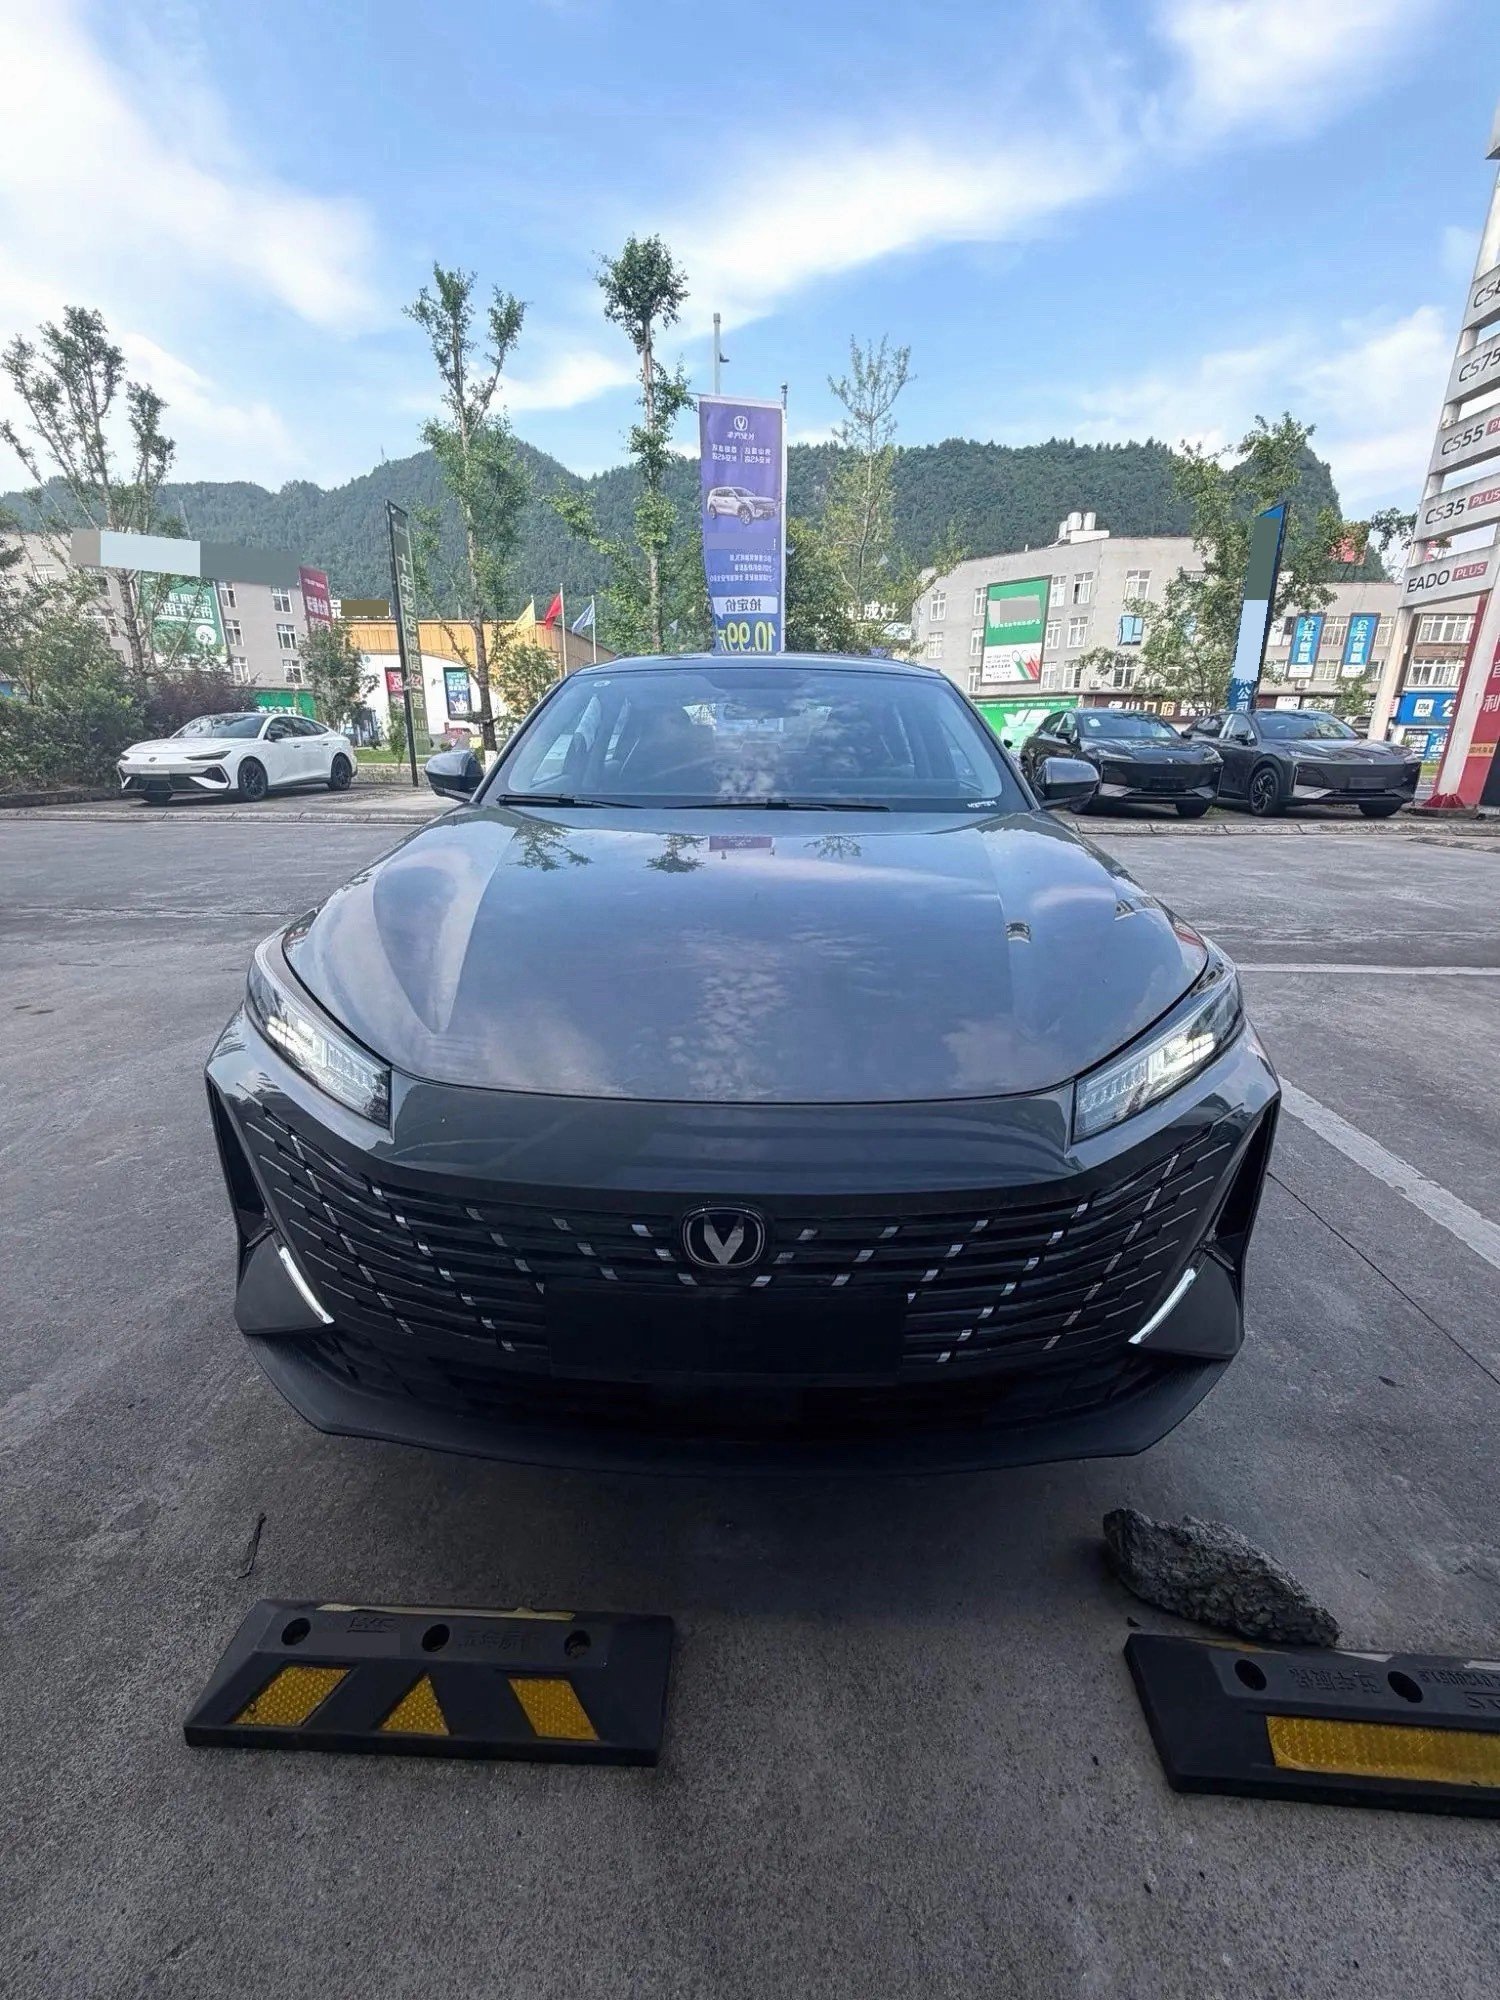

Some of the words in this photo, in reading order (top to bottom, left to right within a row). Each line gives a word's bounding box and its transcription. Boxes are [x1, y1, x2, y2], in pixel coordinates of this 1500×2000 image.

[1441, 422, 1485, 456] CS55
[1425, 498, 1465, 525] CS35
[1472, 489, 1500, 506] PLUS
[1406, 569, 1450, 593] EADO
[1456, 564, 1485, 579] PLUS
